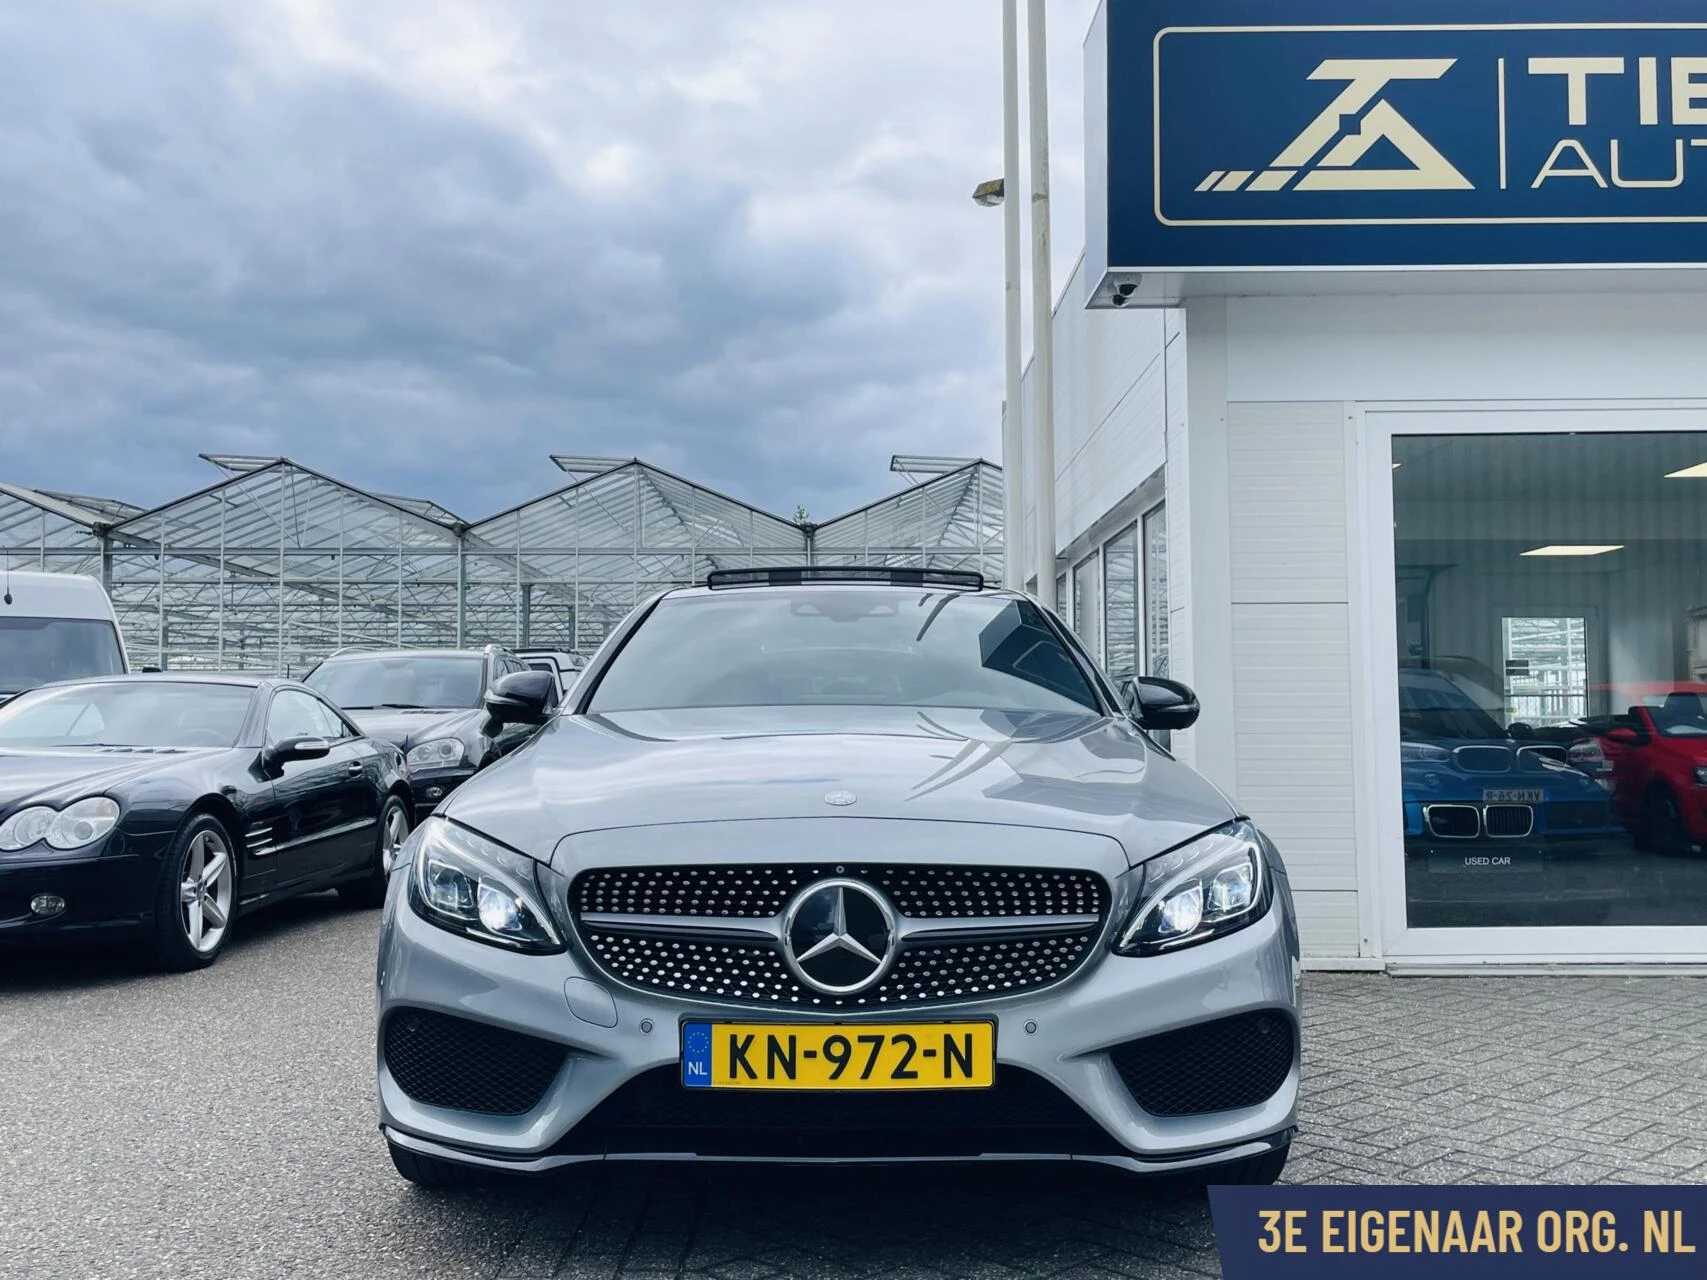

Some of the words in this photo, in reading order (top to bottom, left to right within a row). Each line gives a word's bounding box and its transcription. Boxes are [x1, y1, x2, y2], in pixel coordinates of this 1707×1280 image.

[1532, 139, 1707, 188] AU
[1464, 857, 1489, 865] USED
[1491, 857, 1511, 865] CAR
[688, 1061, 708, 1075] NL
[729, 1033, 973, 1080] KN-972-N
